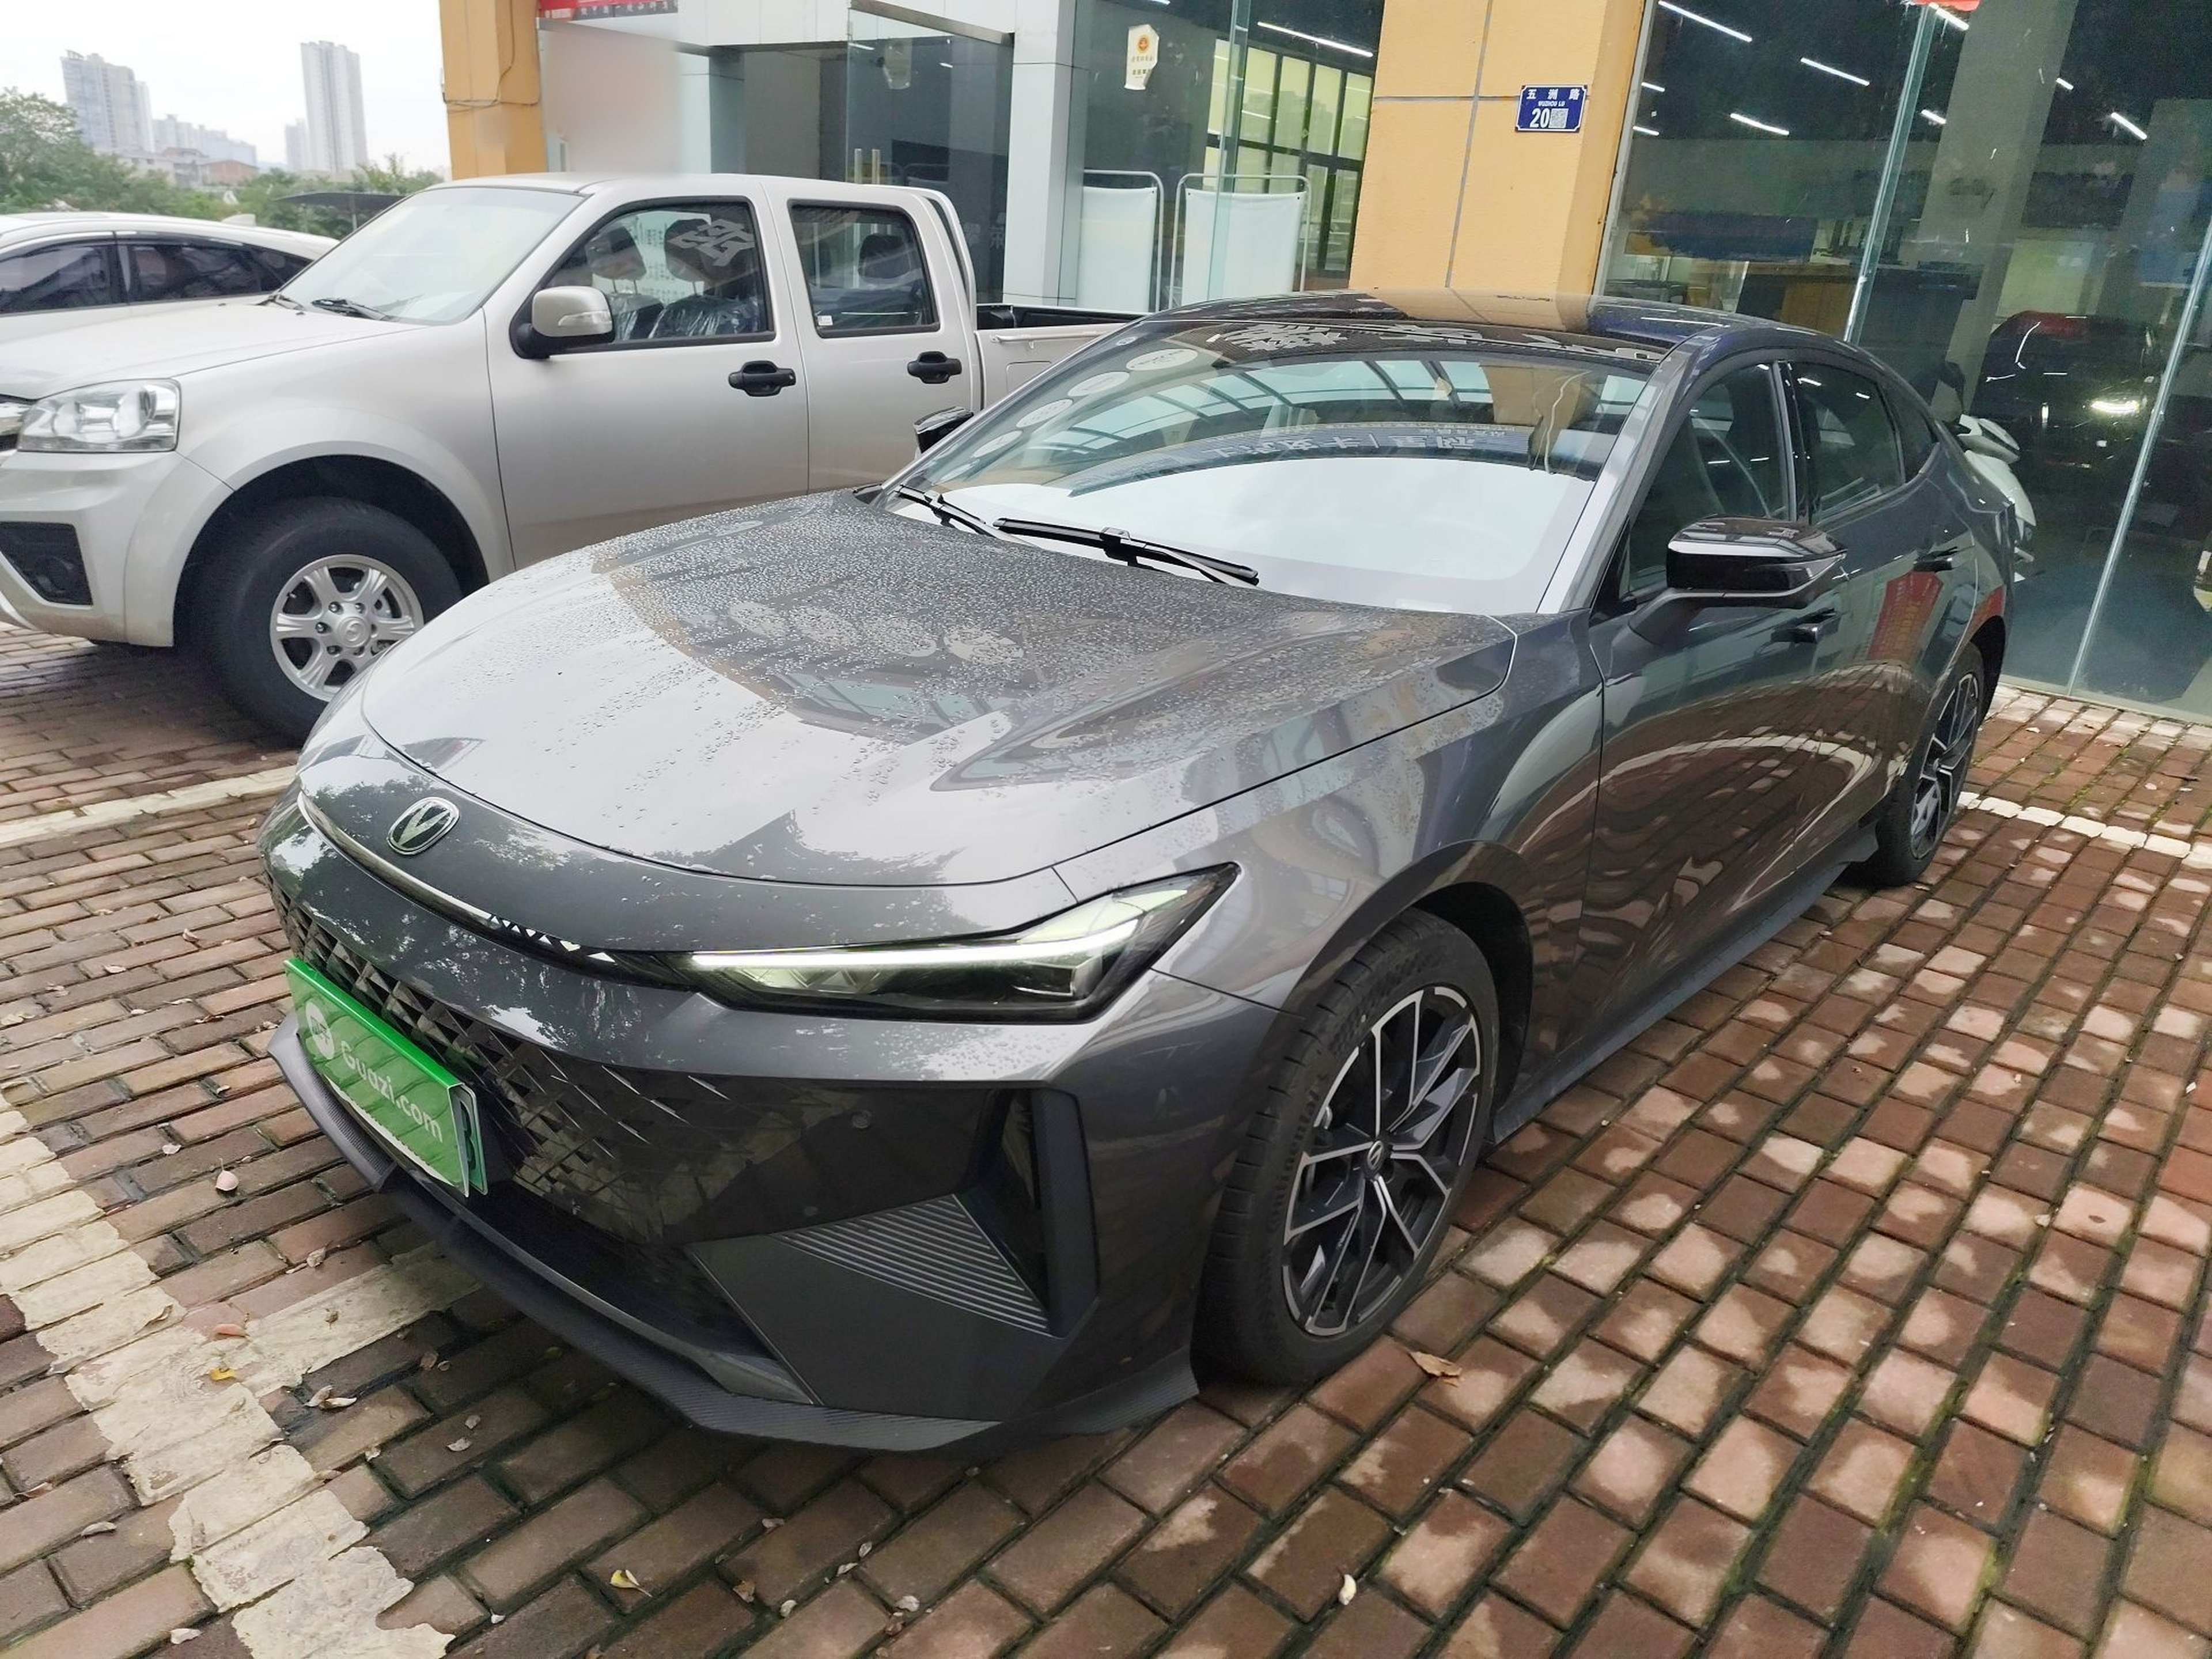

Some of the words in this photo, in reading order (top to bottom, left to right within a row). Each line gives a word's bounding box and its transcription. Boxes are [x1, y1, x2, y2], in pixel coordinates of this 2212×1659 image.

[1527, 88, 1580, 100] 五洲路
[1529, 108, 1550, 128] 20
[341, 1040, 443, 1143] Guazi.com
